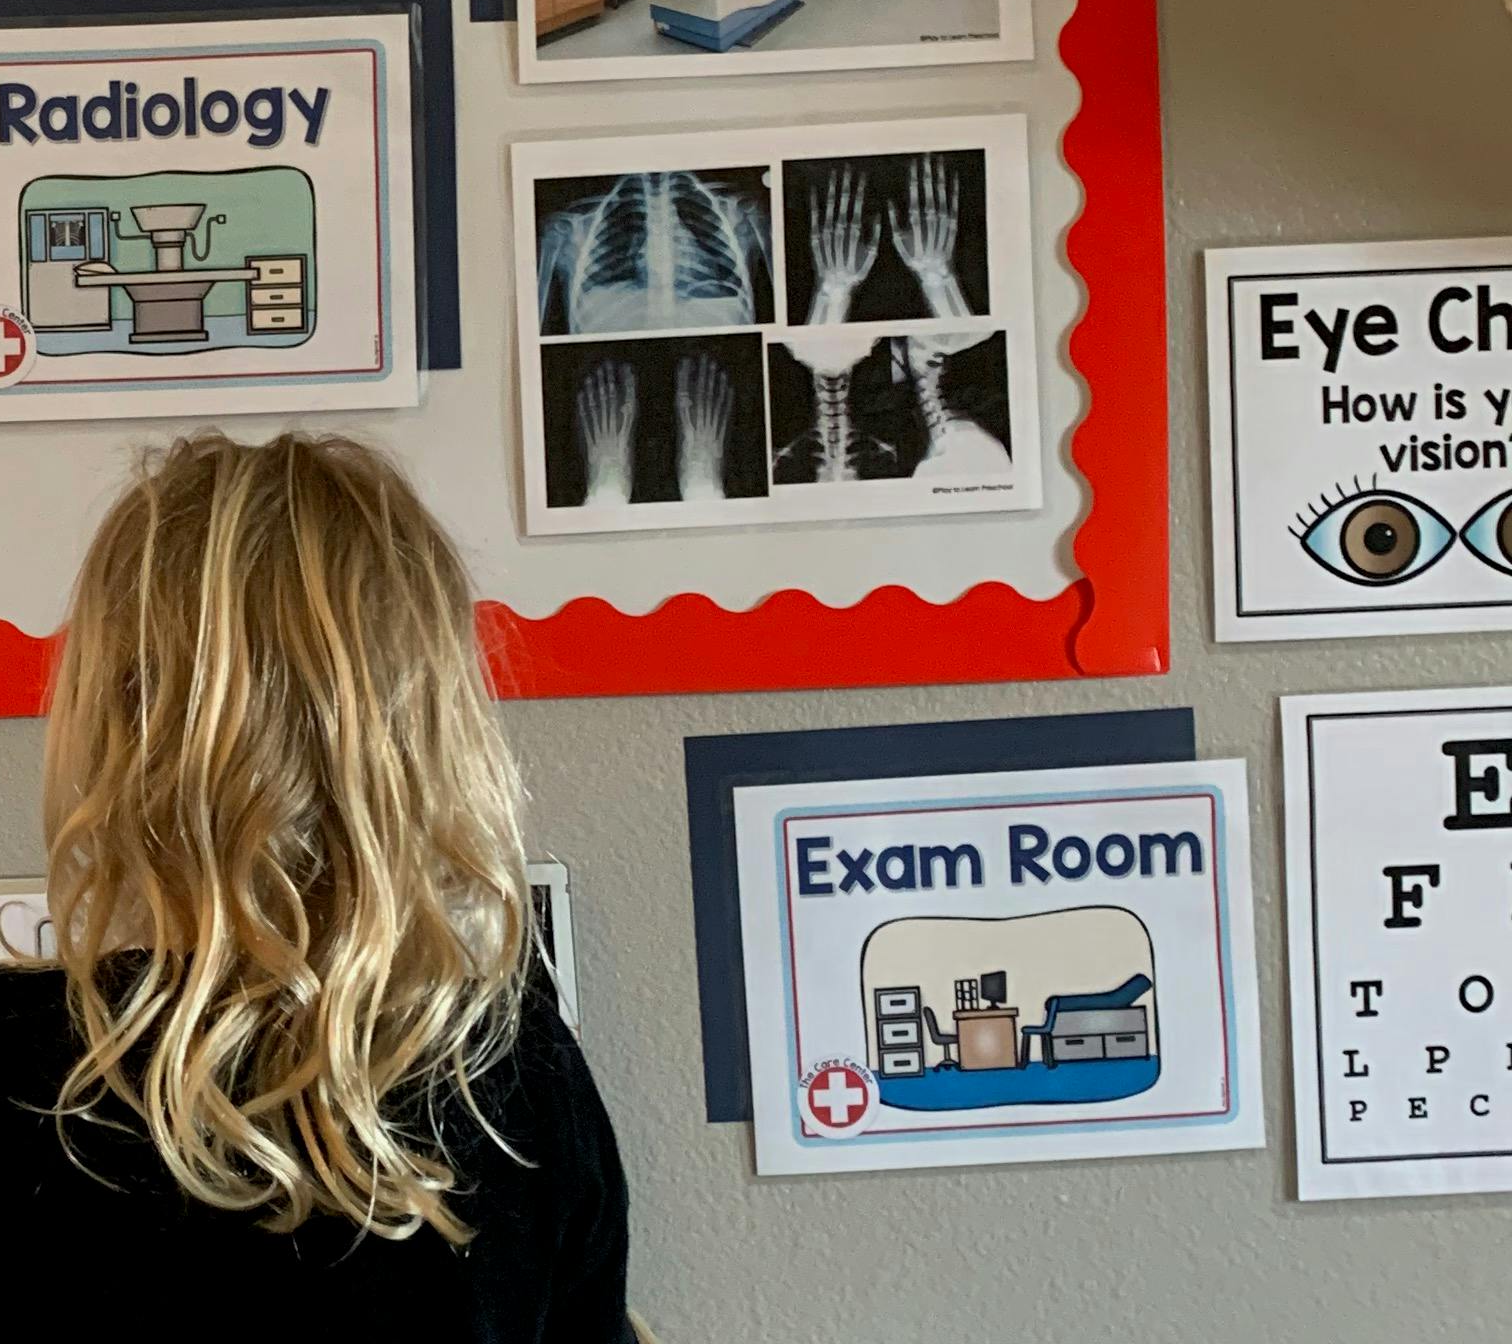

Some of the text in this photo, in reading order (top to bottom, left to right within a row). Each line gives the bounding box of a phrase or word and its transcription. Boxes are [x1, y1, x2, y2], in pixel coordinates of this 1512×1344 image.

[2, 307, 32, 335] Center
[1259, 293, 1399, 373] Eye
[1322, 384, 1417, 424] How
[1434, 382, 1467, 420] is
[1379, 433, 1512, 473] vision
[1442, 739, 1512, 830] E
[795, 824, 1204, 896] Exam Room
[1383, 864, 1440, 928] F
[1350, 980, 1383, 1017] T
[814, 1058, 840, 1072] Care
[843, 1057, 873, 1084] Center
[1343, 1046, 1451, 1077] L P
[1349, 1094, 1490, 1121] P E C
